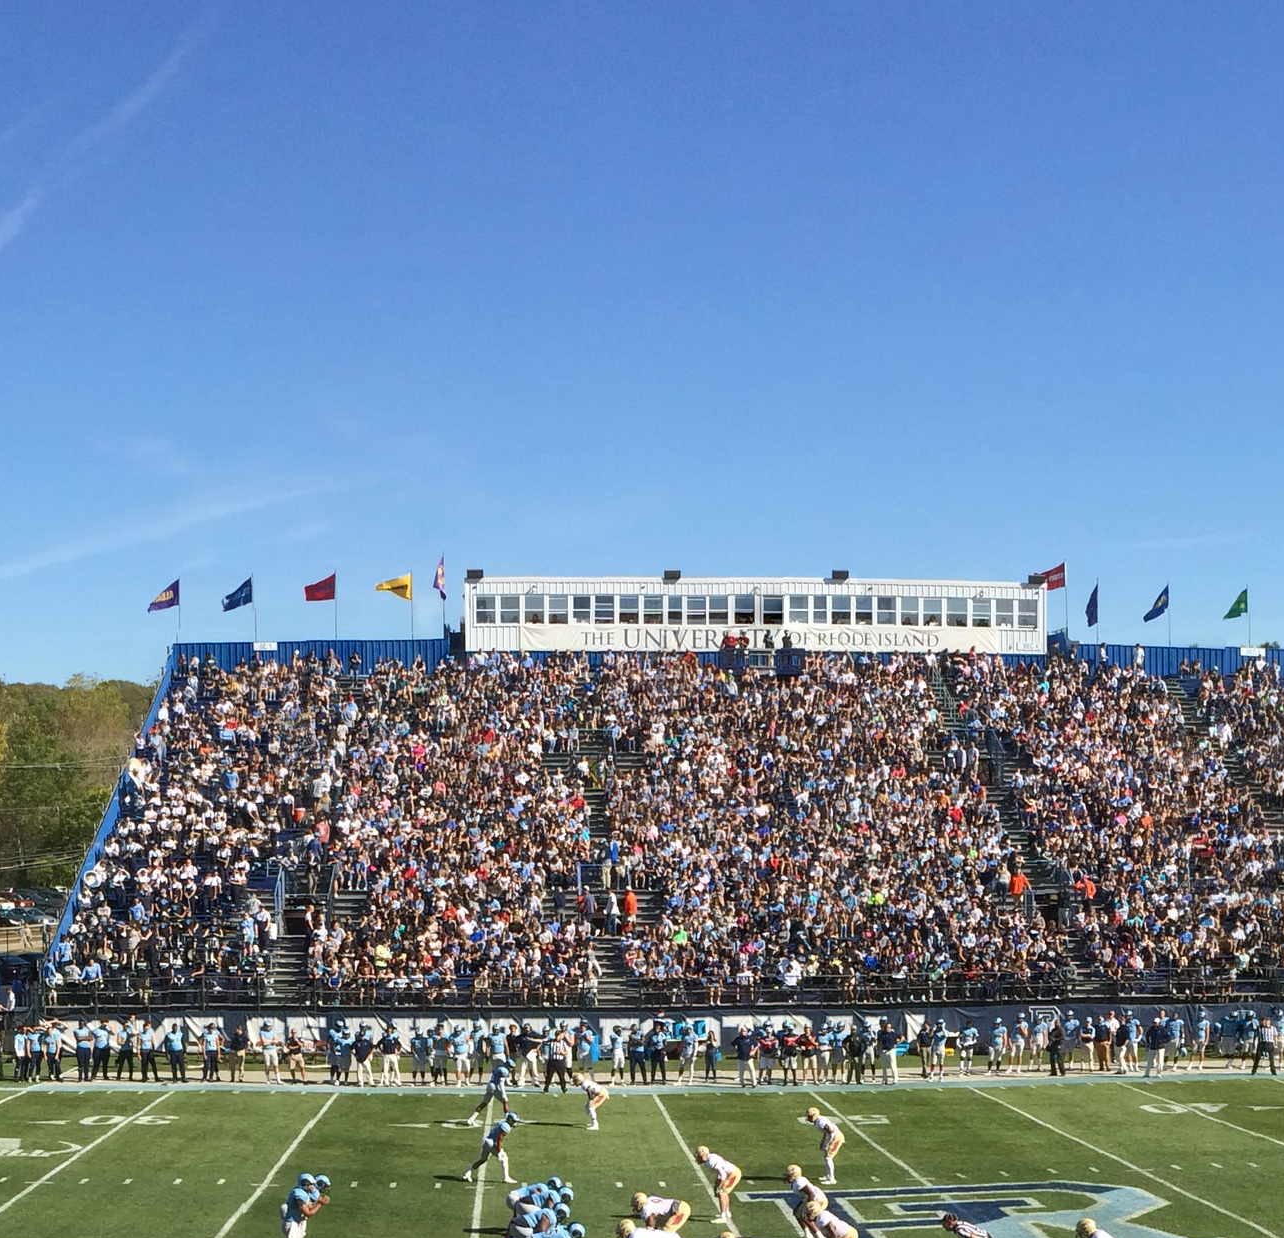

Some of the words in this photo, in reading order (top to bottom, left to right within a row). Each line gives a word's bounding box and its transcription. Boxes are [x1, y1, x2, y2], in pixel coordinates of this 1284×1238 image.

[581, 632, 614, 646] THE
[623, 628, 782, 649] UNIVERT
[791, 632, 811, 644] OF
[878, 632, 939, 648] ISLAND
